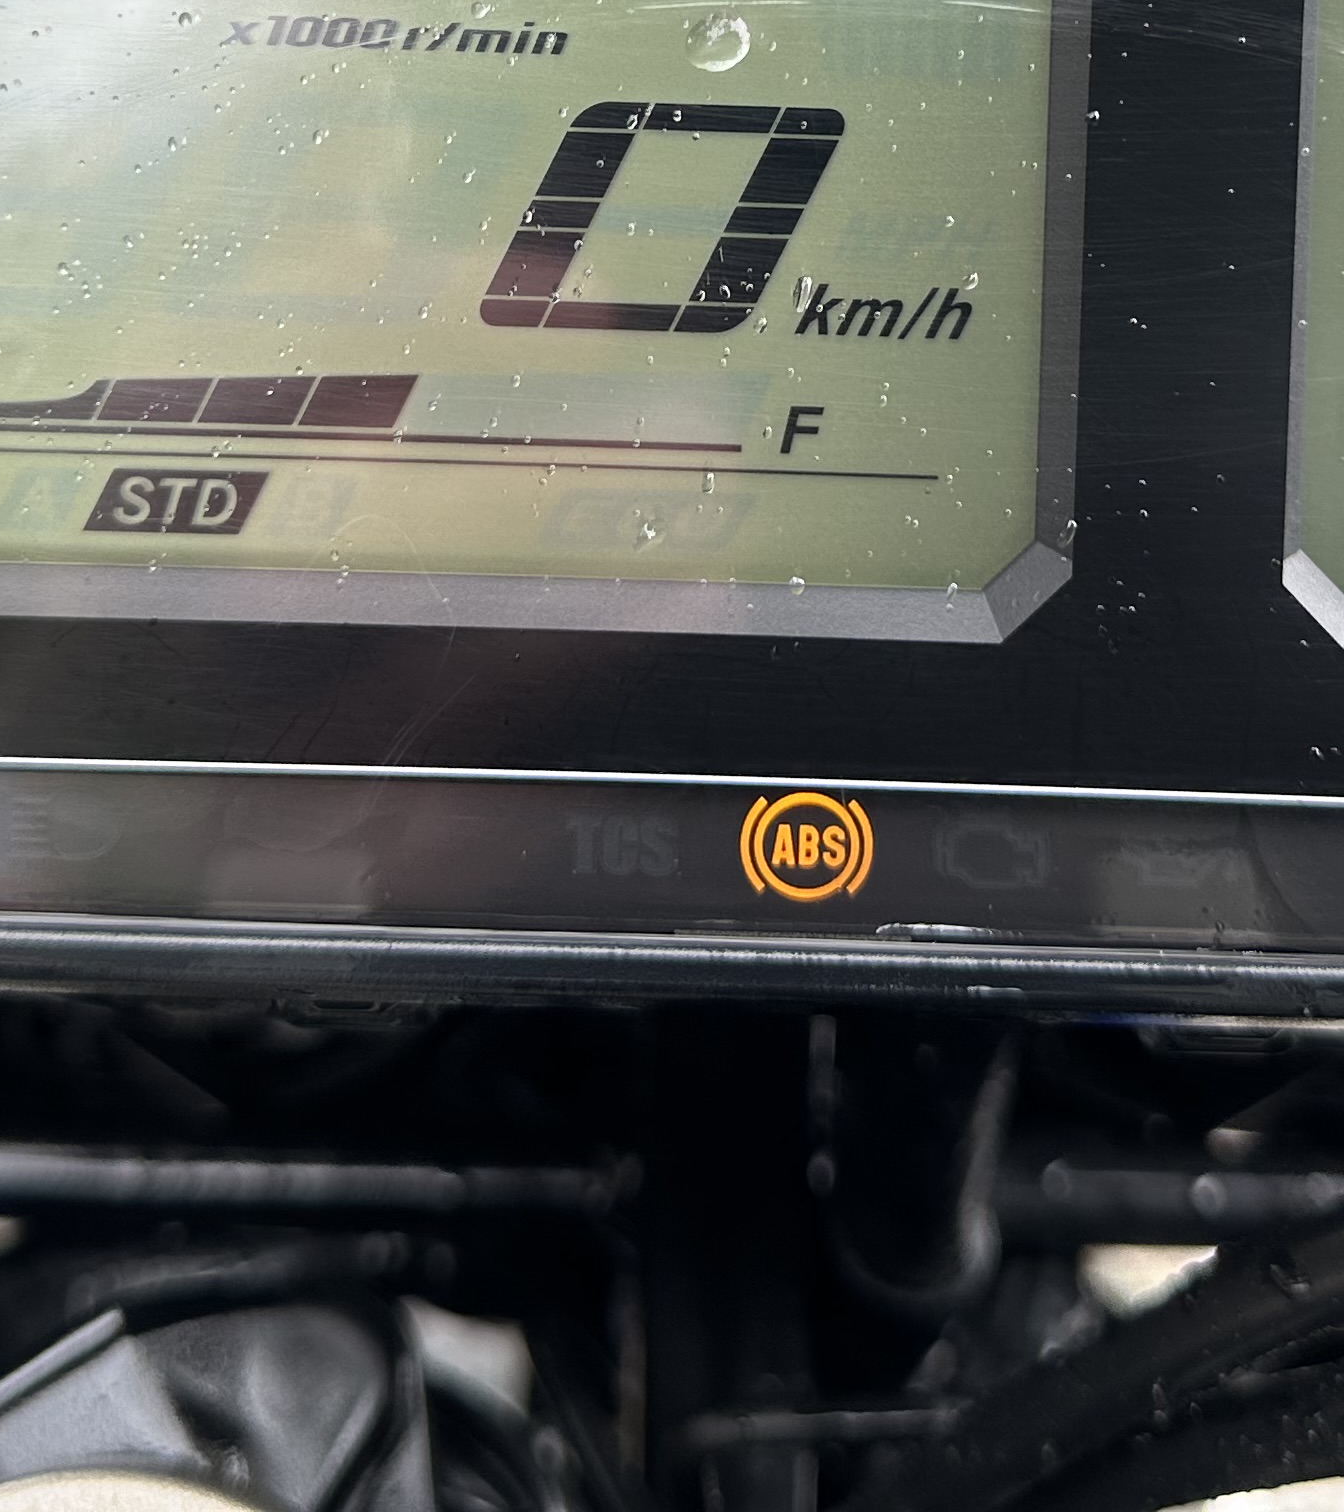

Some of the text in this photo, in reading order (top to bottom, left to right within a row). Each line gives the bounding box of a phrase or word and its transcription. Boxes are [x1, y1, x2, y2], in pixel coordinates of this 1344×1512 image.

[480, 101, 846, 333] 0
[794, 285, 976, 340] km/h
[780, 406, 825, 455] F
[112, 475, 238, 527] STD
[567, 813, 680, 877] TCS
[770, 822, 848, 872] ABS
